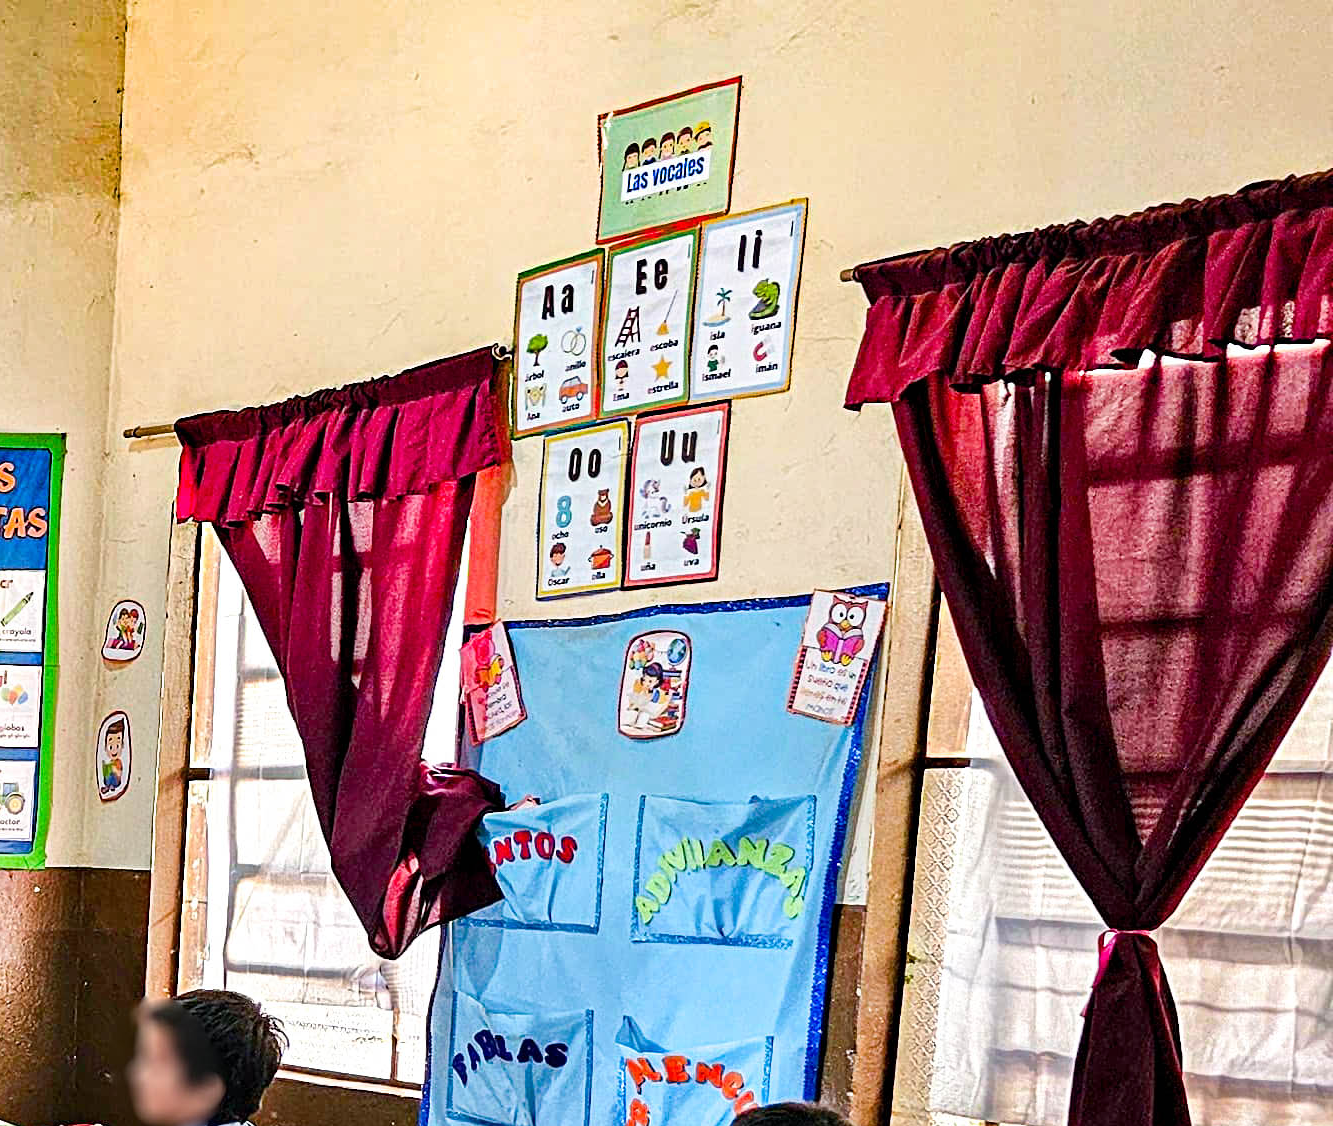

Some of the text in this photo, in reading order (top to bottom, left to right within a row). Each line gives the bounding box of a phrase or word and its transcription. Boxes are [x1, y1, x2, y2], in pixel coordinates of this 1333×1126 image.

[626, 155, 704, 192] Las vocales
[493, 830, 578, 866] NTOS
